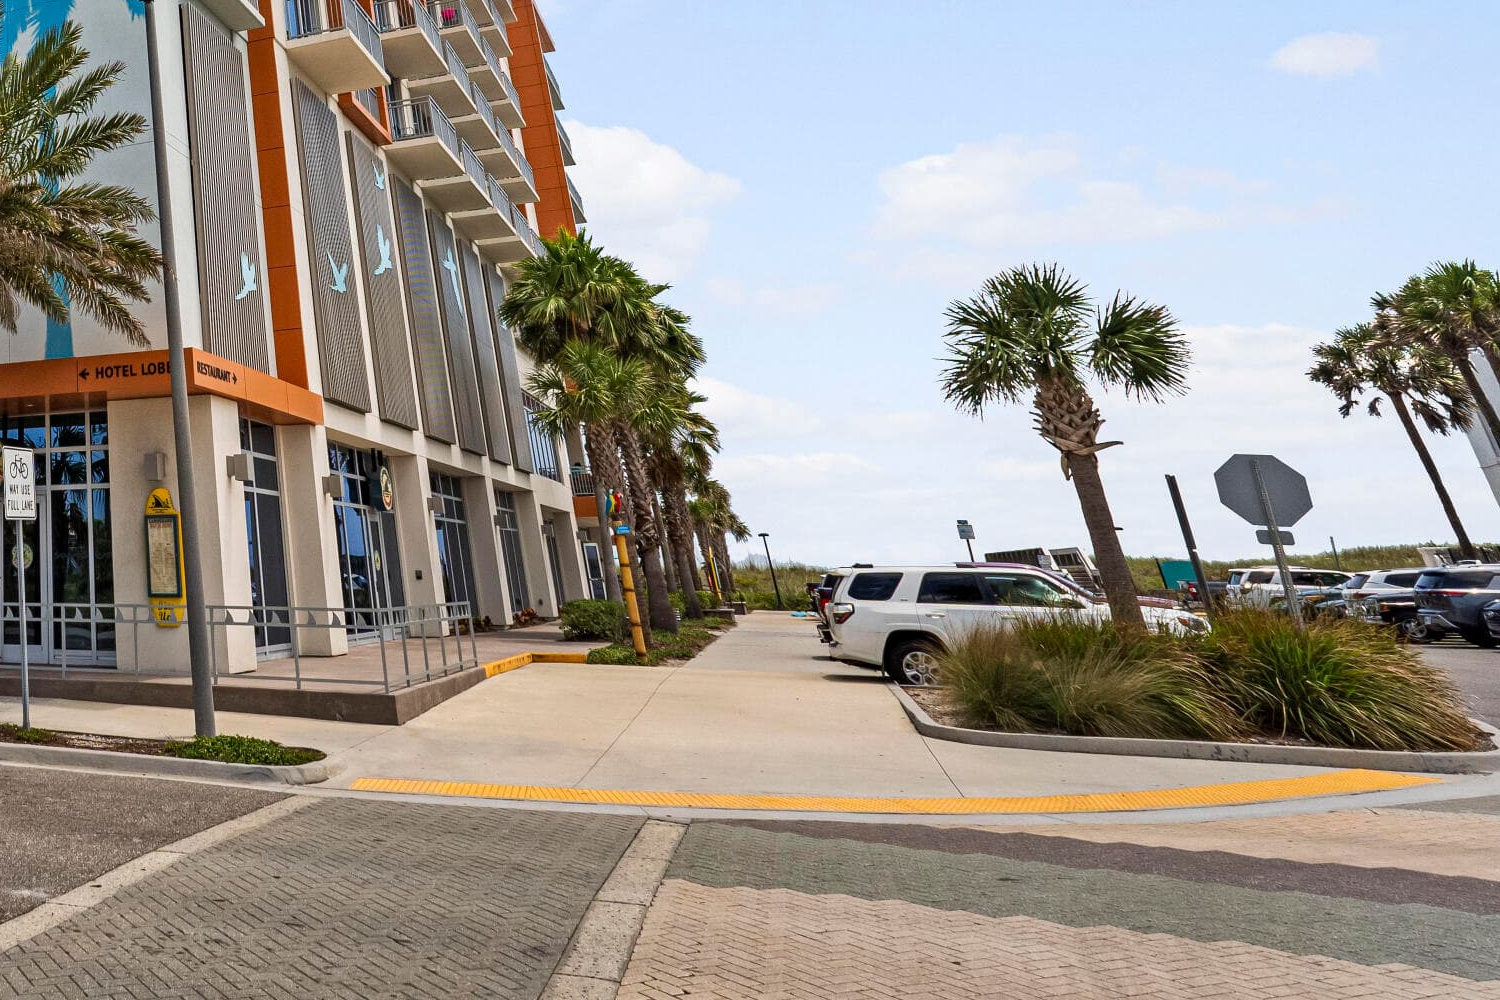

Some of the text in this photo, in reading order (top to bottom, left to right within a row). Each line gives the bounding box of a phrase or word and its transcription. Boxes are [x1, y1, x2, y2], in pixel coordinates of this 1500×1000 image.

[95, 364, 137, 380] HOTEL
[196, 360, 231, 384] RESTAURANT
[9, 484, 31, 496] MAY USE
[7, 499, 34, 511] FULL LANE
